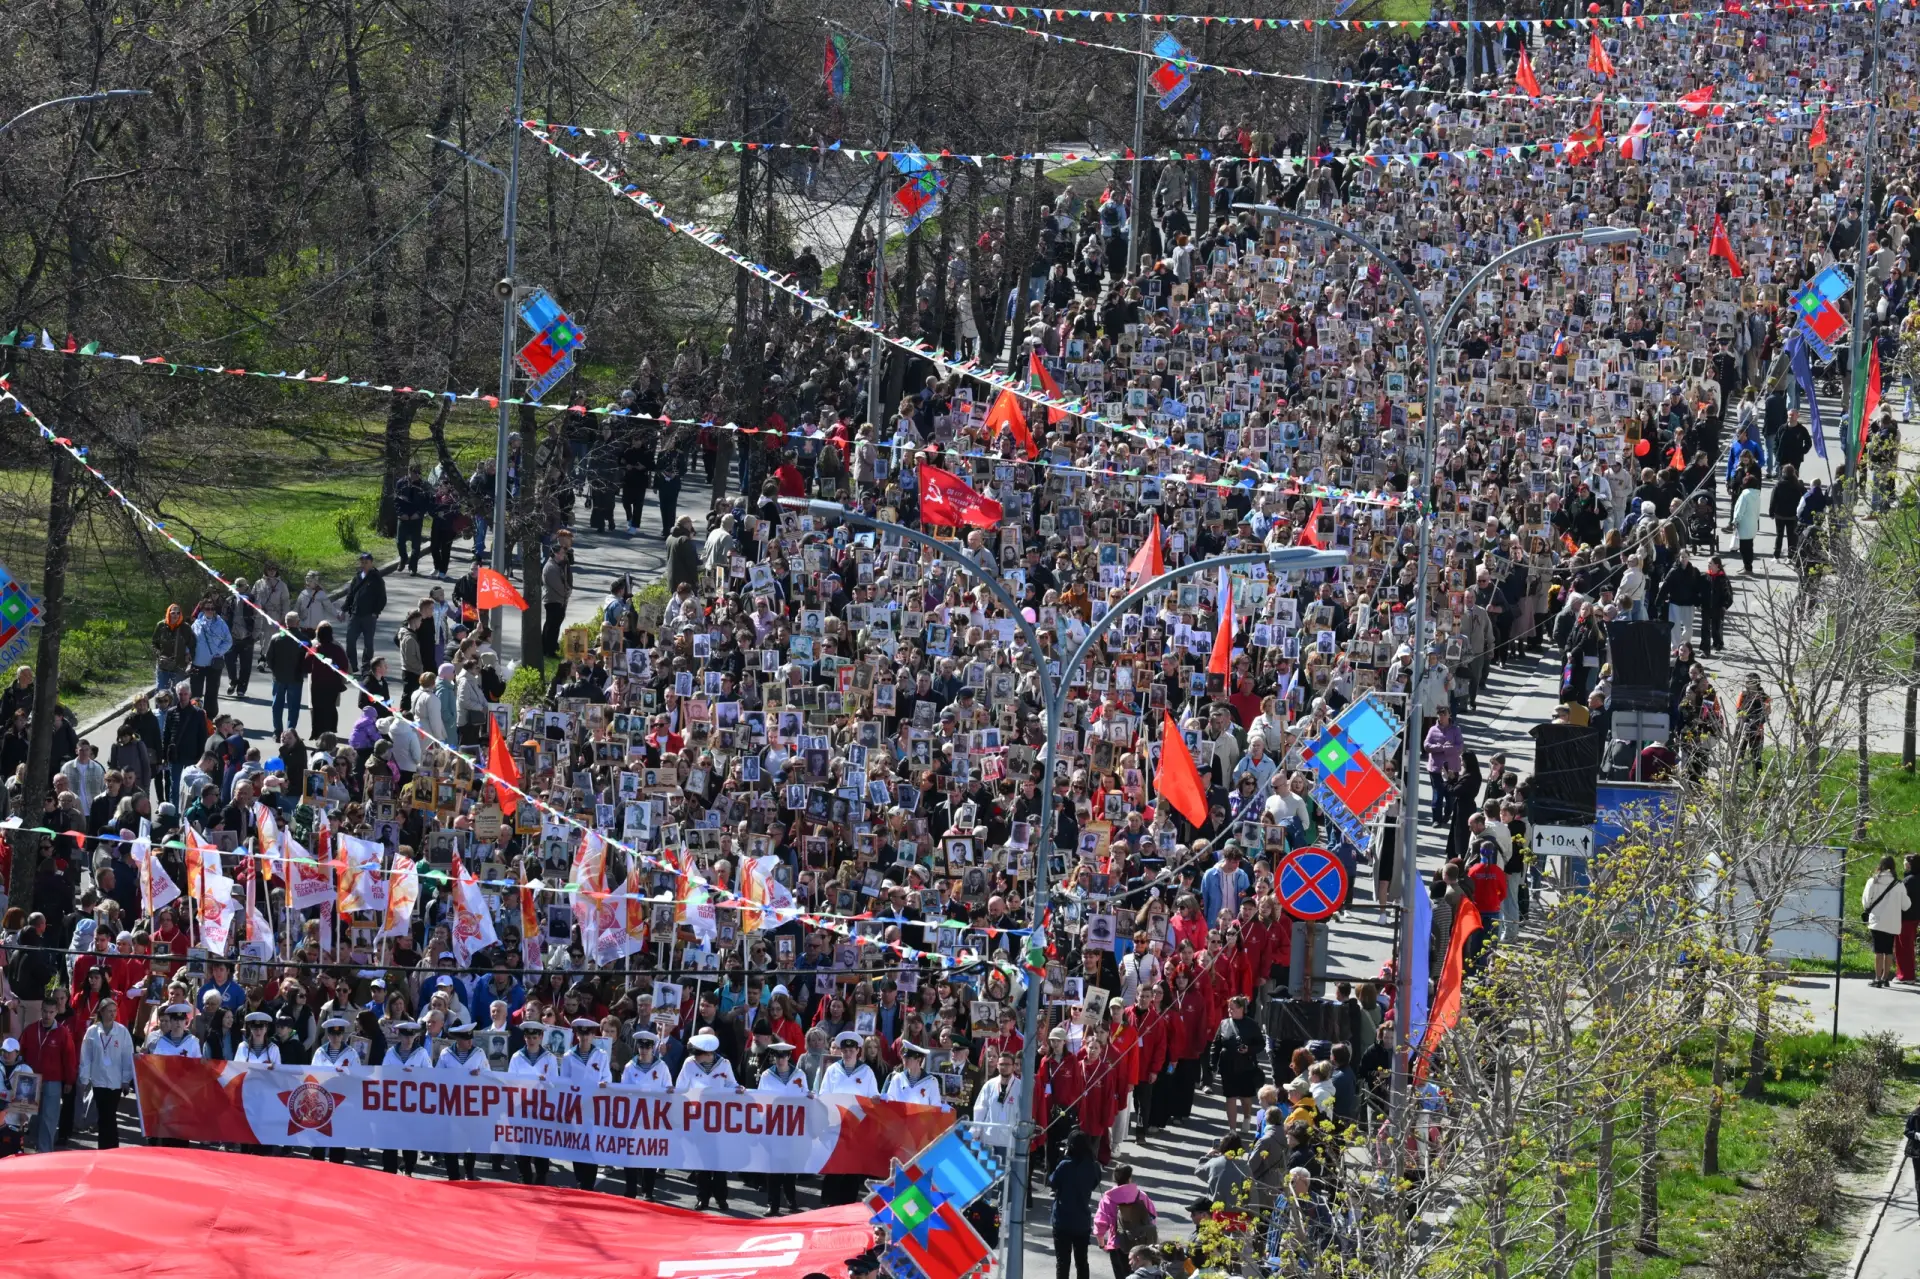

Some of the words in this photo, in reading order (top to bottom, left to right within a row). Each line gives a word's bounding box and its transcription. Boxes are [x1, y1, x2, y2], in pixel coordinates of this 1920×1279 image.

[1312, 785, 1371, 852] KARJALA
[1551, 835, 1564, 846] 10
[362, 1080, 583, 1125] БЕССМЕРТНЫЙ
[592, 1095, 673, 1131] ПОЛК
[683, 1101, 805, 1136] РОССИИ
[494, 1124, 591, 1152] РЕСПУБЛИКА
[596, 1134, 669, 1157] КАРЕЛИЯ
